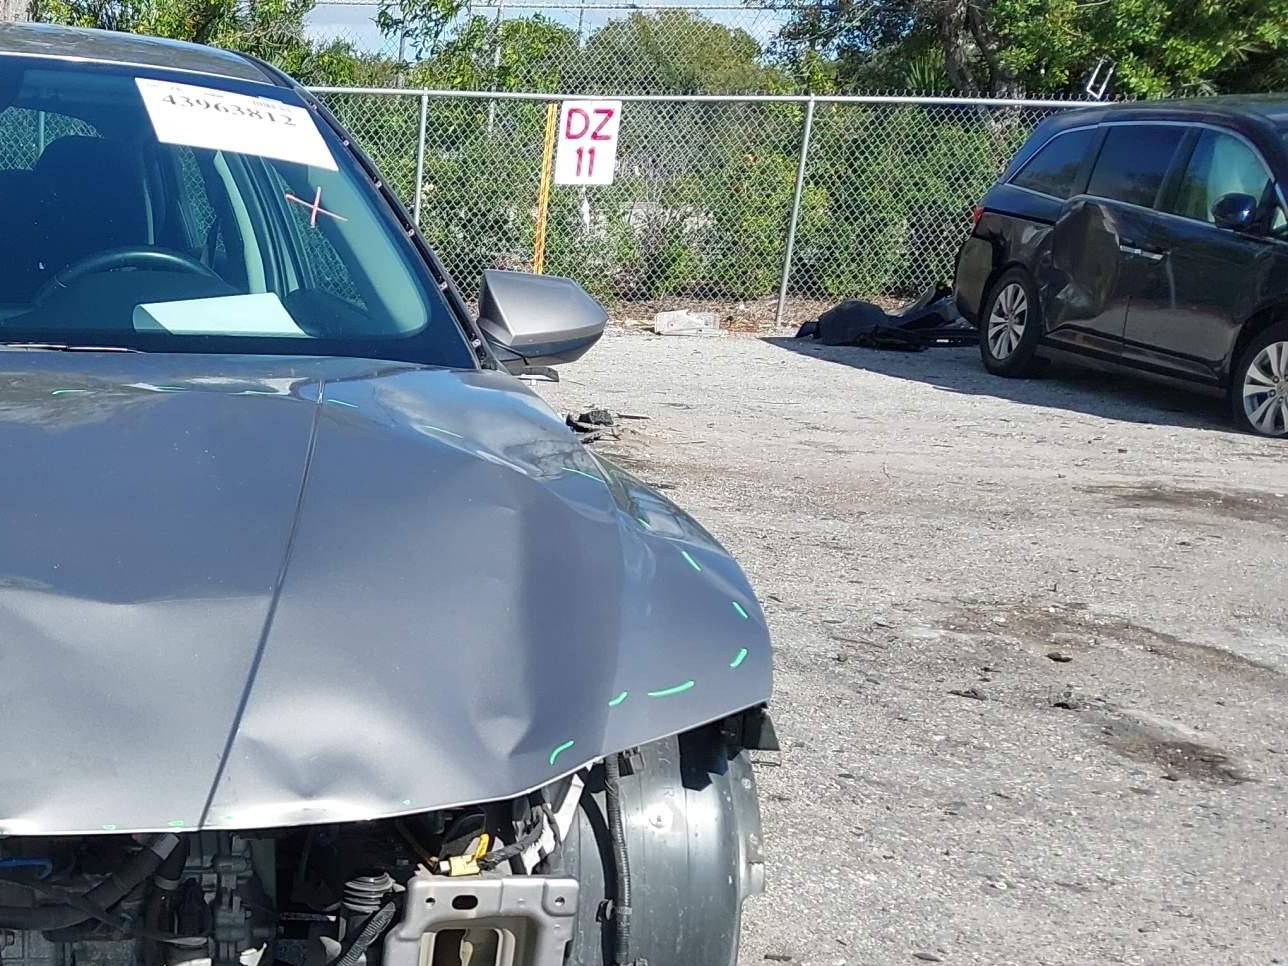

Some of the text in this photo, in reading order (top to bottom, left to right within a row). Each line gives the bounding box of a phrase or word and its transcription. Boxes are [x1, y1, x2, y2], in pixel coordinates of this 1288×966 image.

[162, 94, 297, 126] 43963812
[565, 108, 615, 140] DZ
[576, 146, 596, 177] 11
